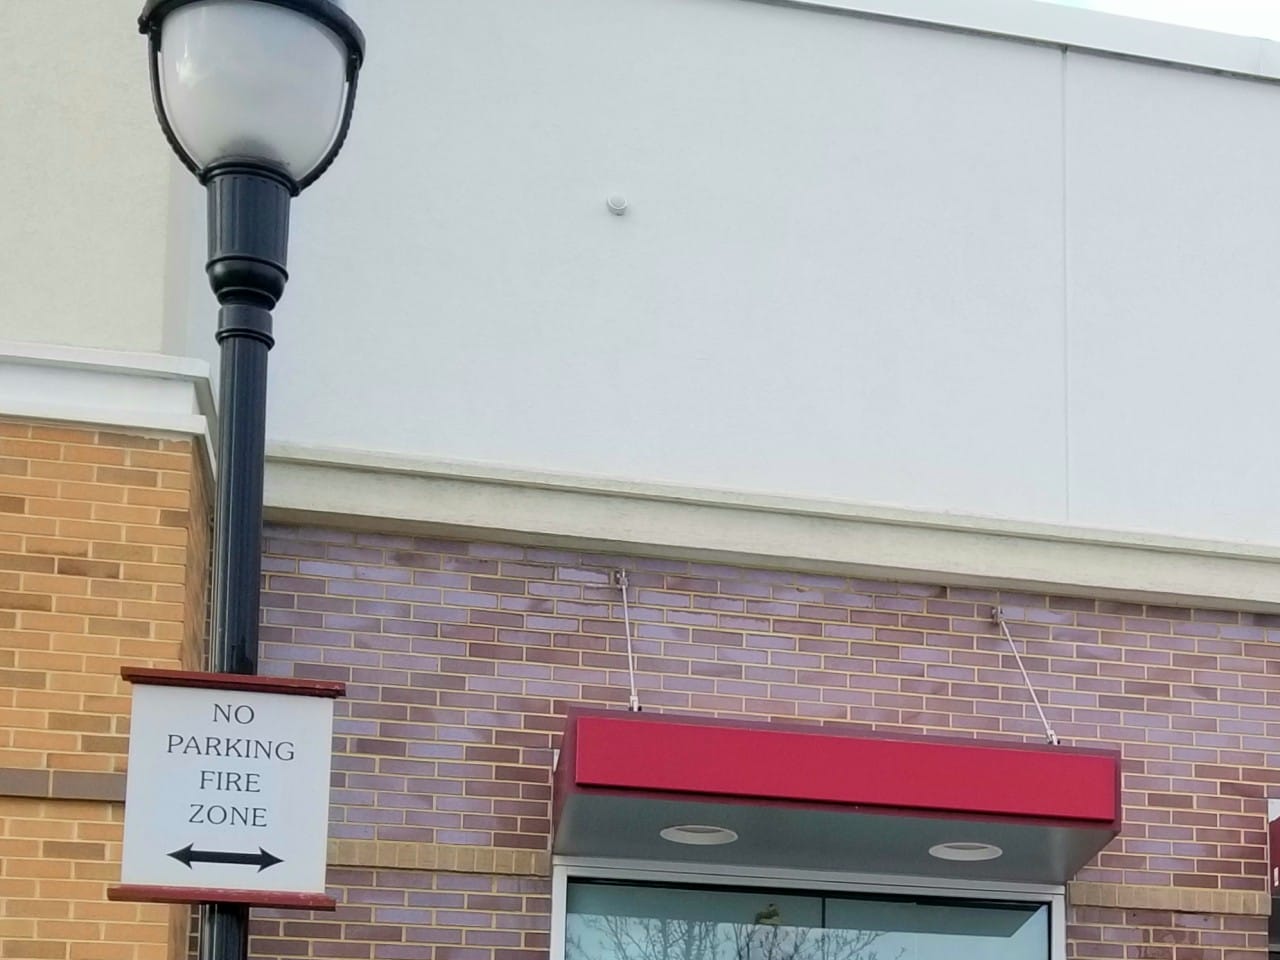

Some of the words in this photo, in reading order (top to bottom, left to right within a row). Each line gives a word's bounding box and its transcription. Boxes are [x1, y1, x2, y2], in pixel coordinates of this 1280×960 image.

[212, 703, 255, 725] NO
[166, 733, 296, 762] PARKING
[199, 770, 262, 793] FIRE
[188, 803, 268, 828] ZONE
